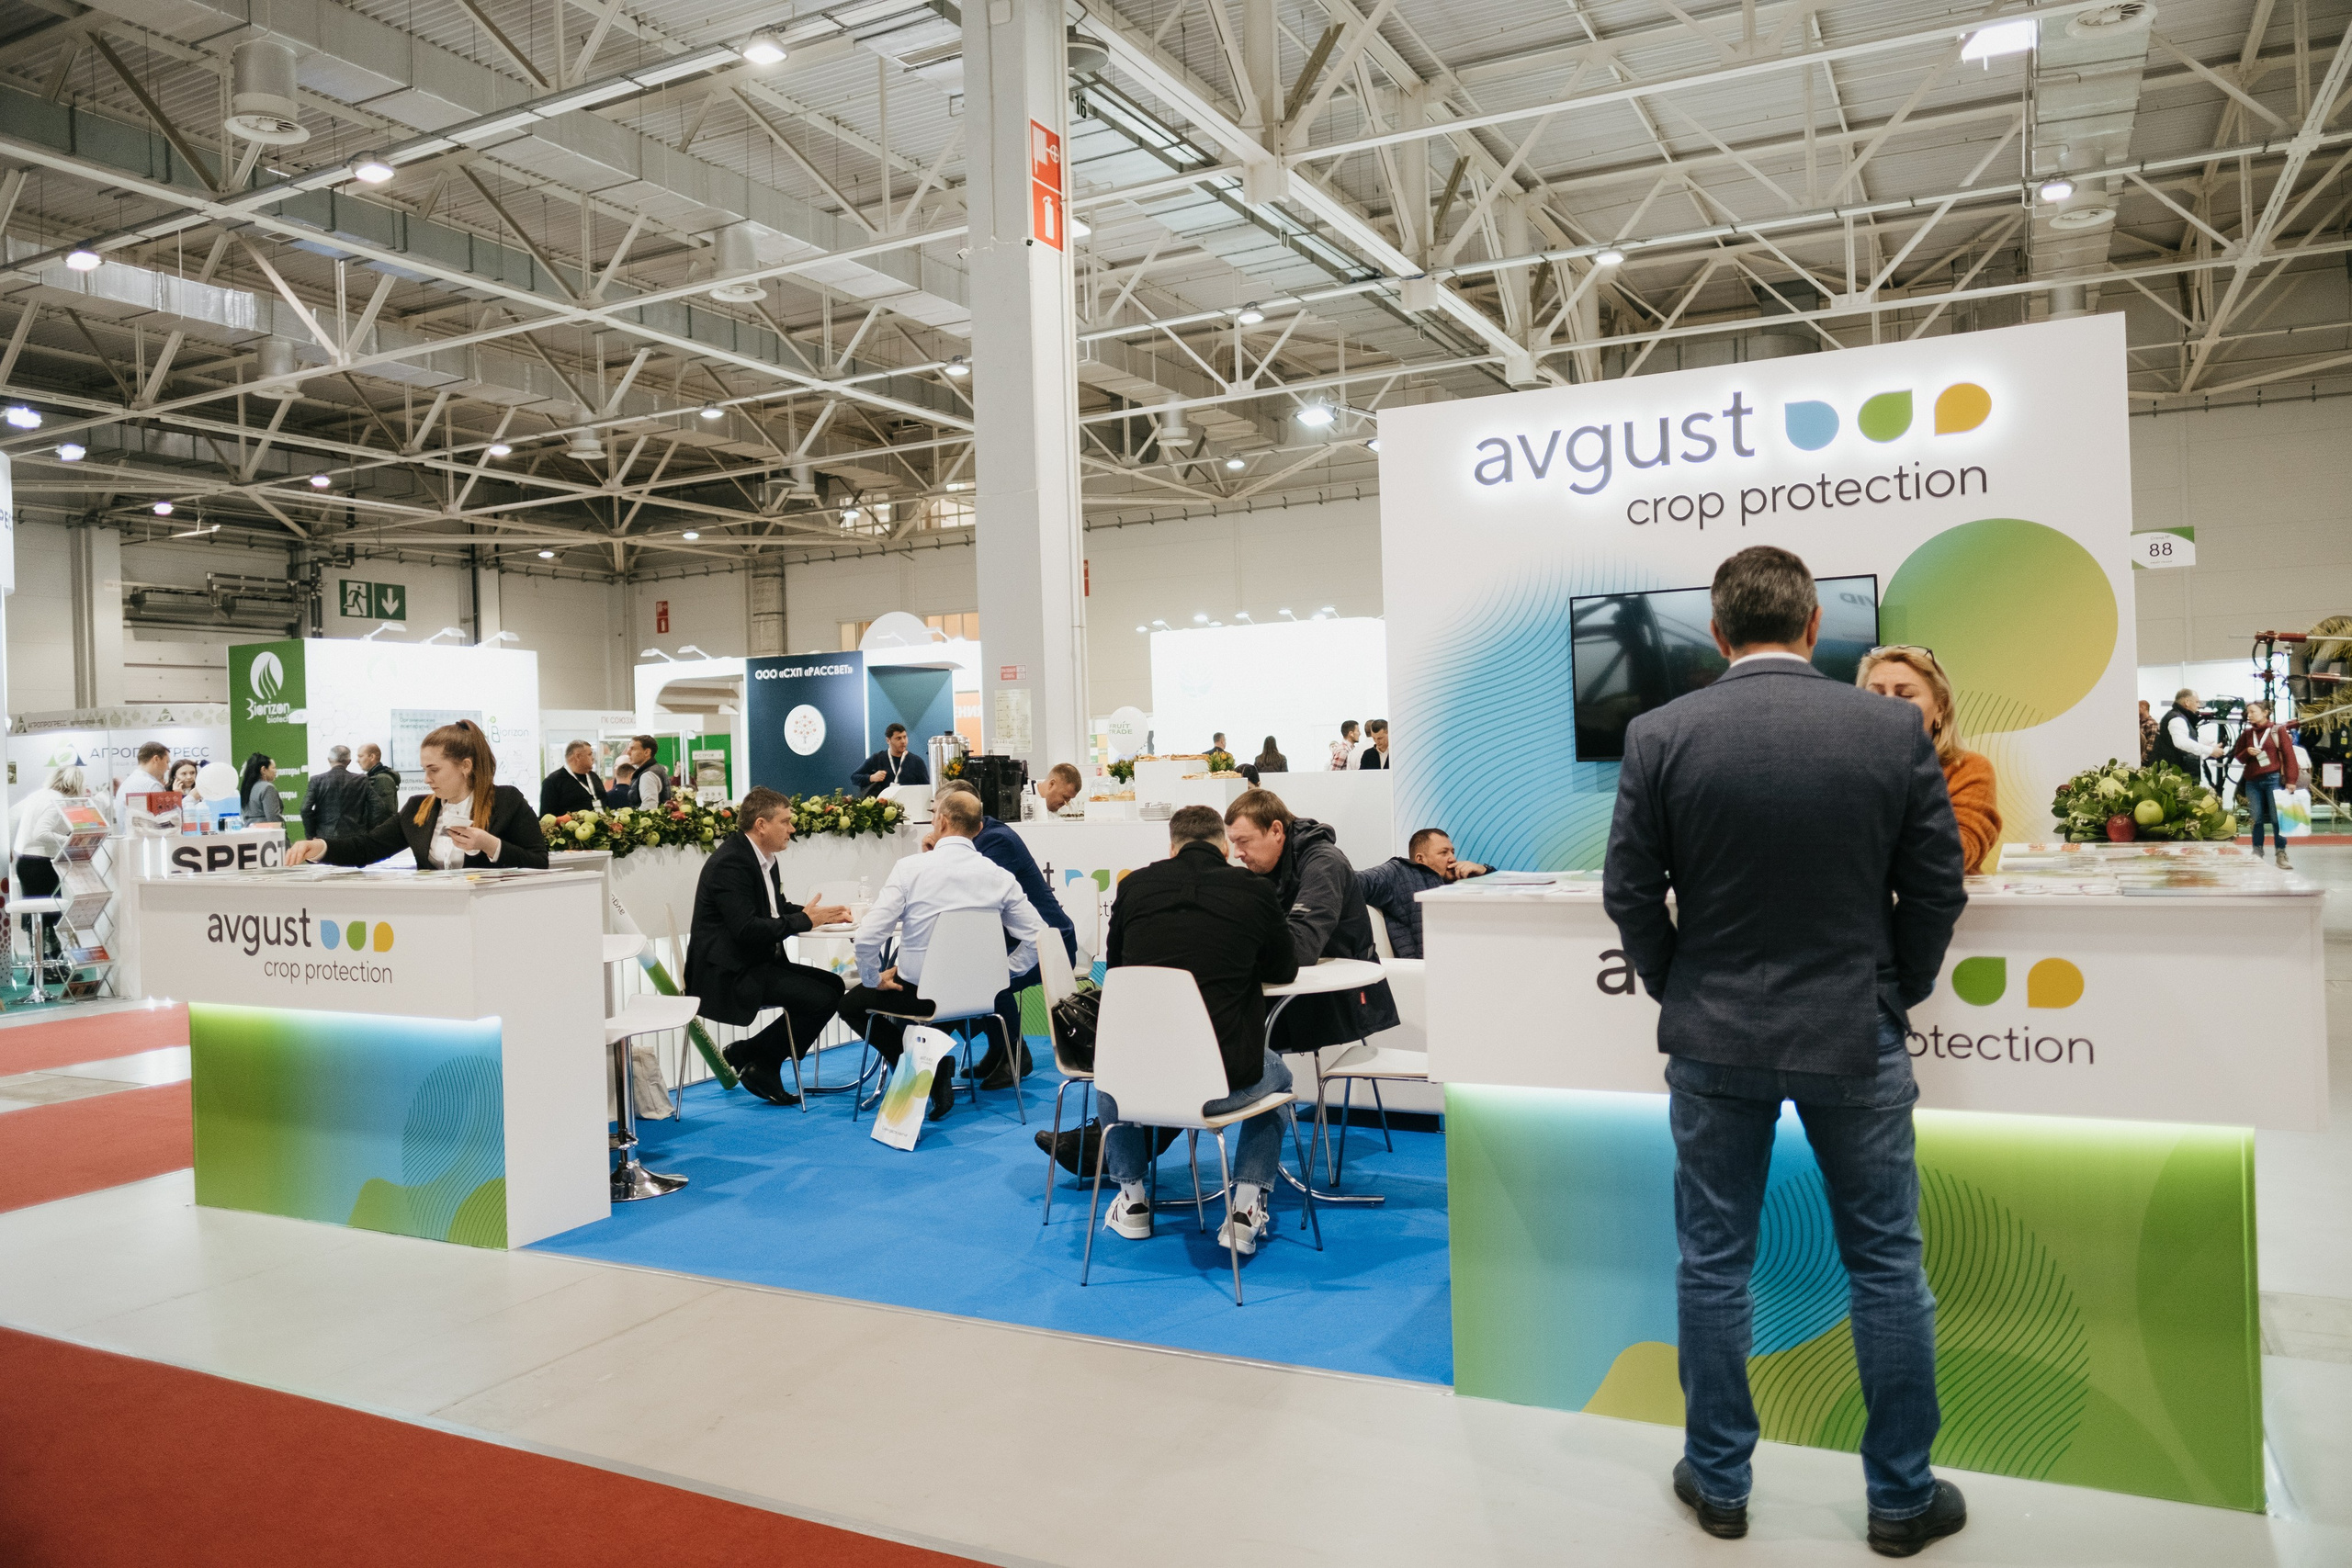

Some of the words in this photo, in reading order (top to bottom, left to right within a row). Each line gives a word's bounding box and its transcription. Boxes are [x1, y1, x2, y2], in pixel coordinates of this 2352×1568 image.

[1074, 95, 1087, 118] 16
[1474, 391, 1755, 495] avgust
[1627, 491, 1724, 530] crop
[1741, 460, 1988, 526] protection
[2149, 542, 2173, 558] 88
[754, 669, 777, 680] ООО
[804, 664, 853, 677] «РАССВЕТ»
[610, 716, 636, 725] СОЮЗХ
[89, 746, 209, 759] АГРОПРЕСС
[207, 908, 312, 956] avgust
[264, 961, 300, 984] crop
[305, 960, 393, 986] protection
[1905, 1024, 2095, 1065] otection
